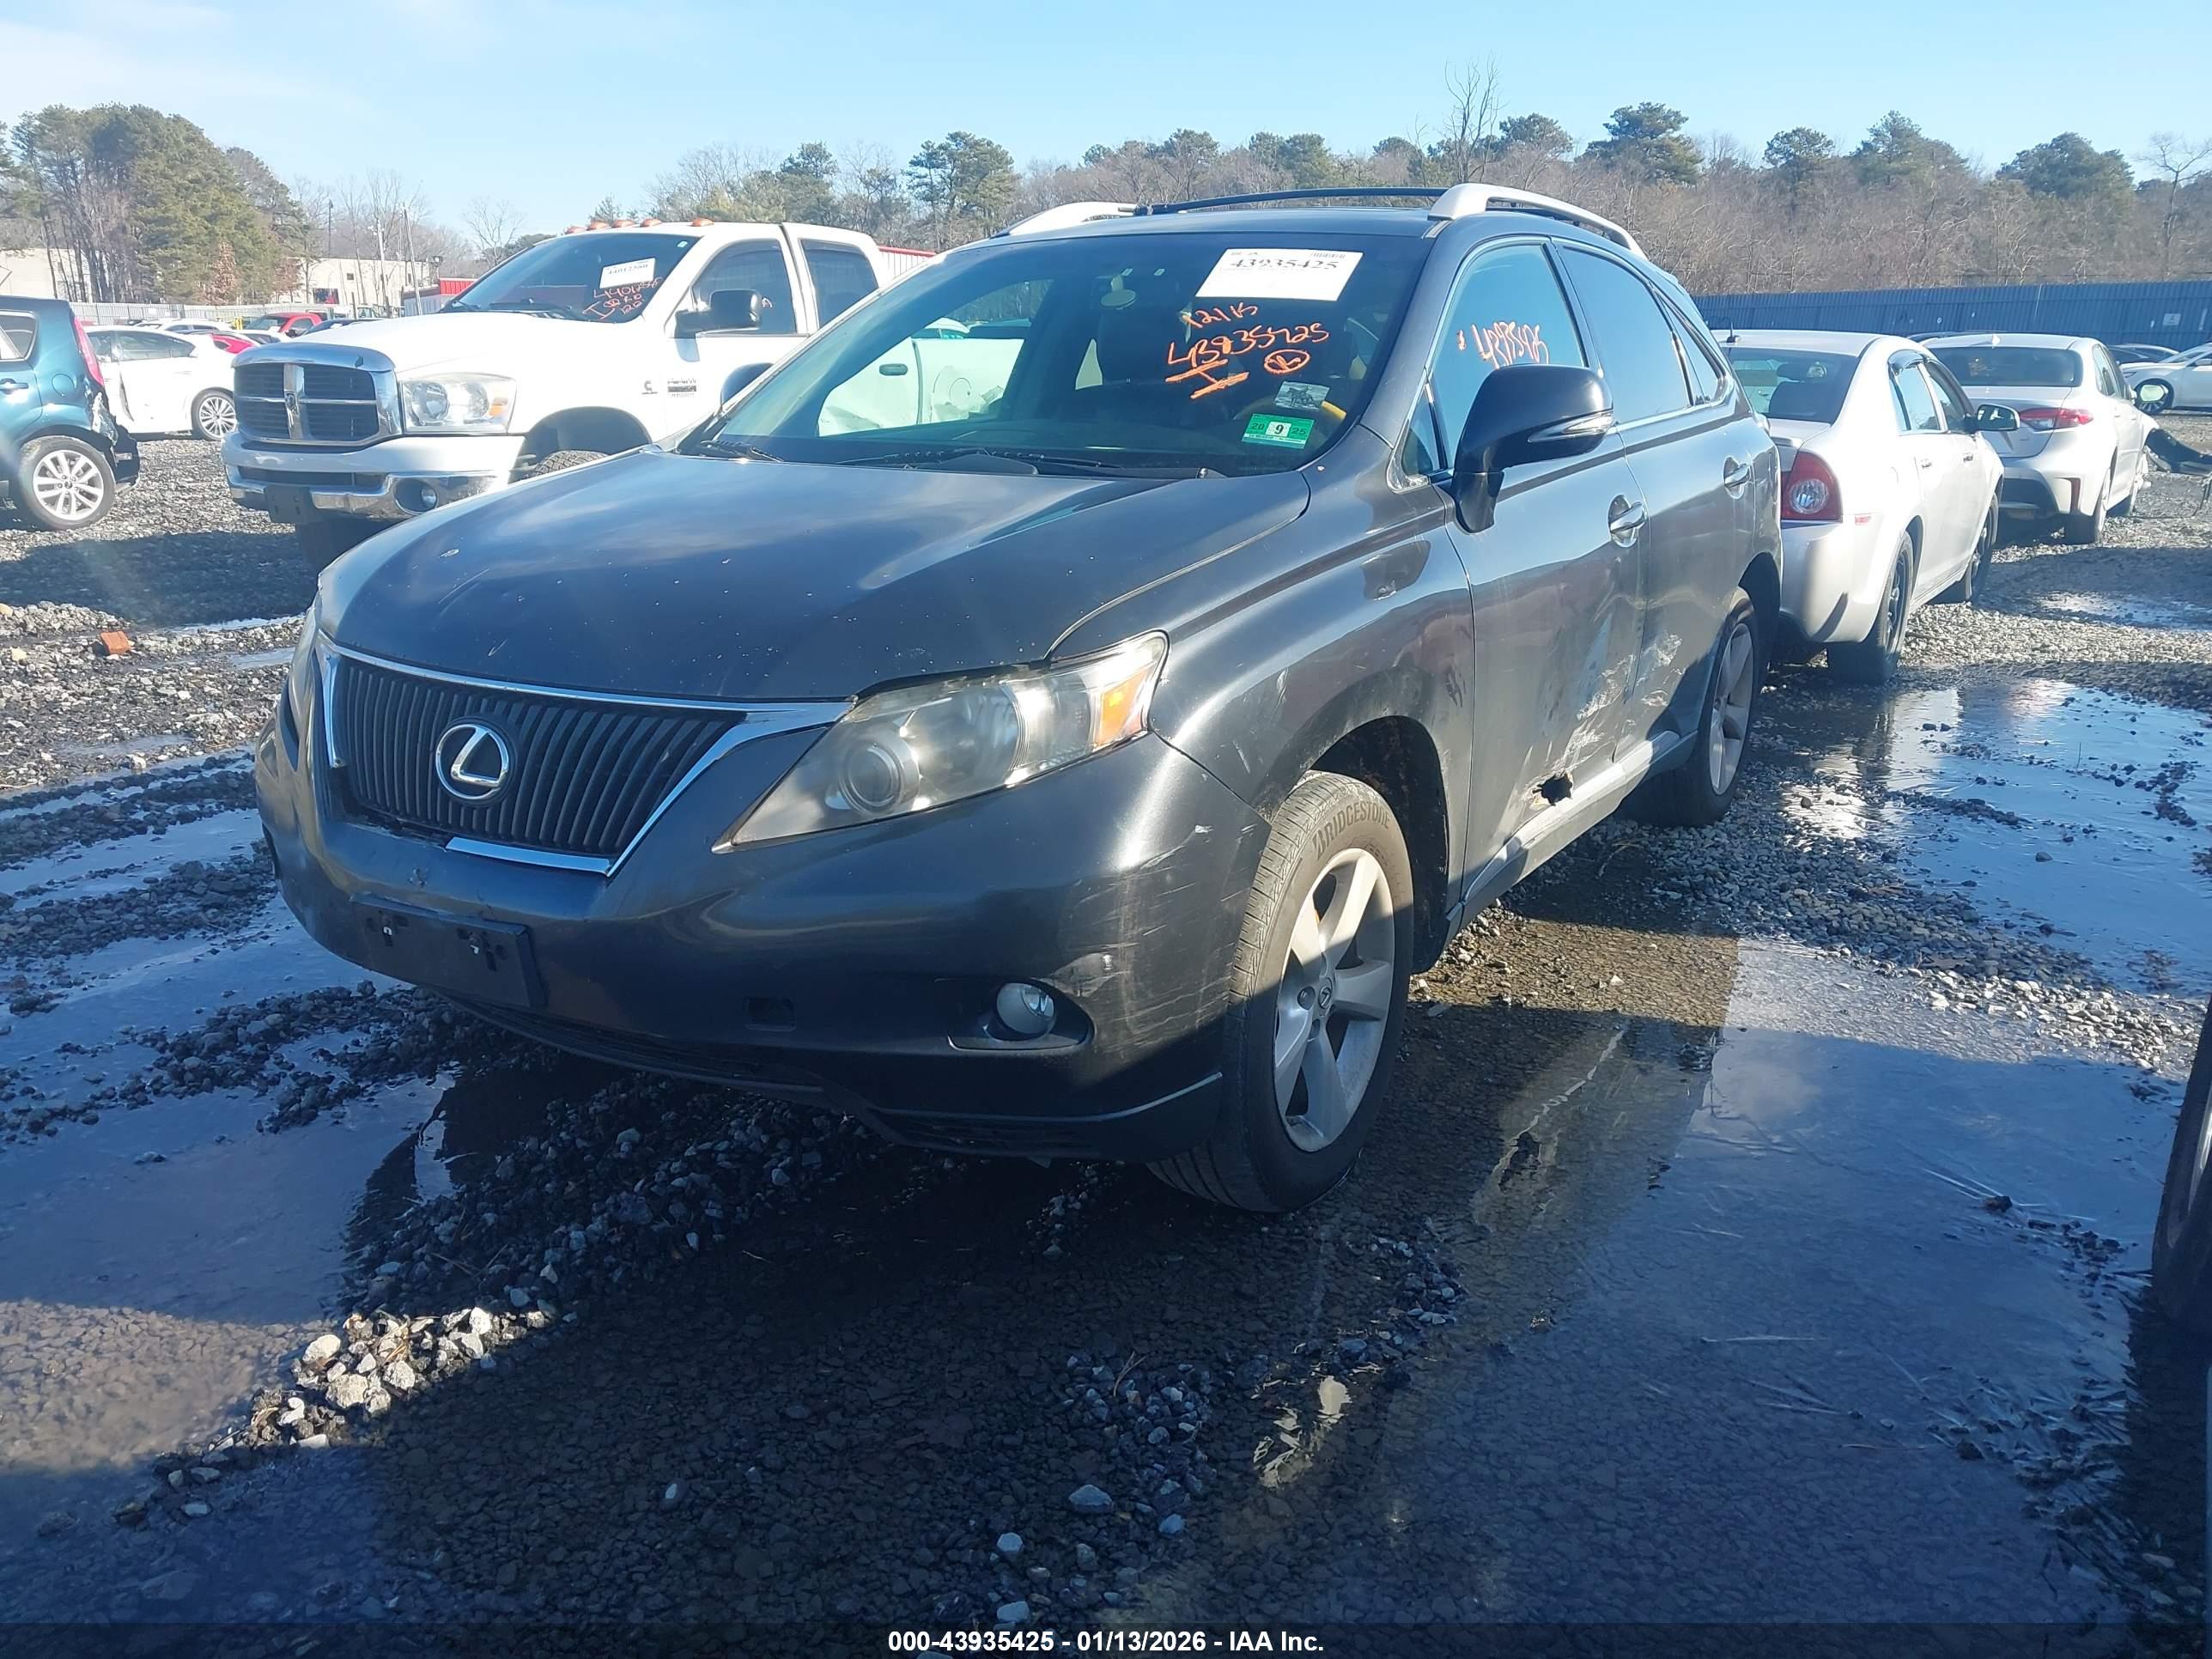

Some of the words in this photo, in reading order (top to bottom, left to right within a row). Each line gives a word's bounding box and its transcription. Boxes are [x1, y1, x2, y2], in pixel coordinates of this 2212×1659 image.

[1231, 258, 1340, 270] 43935425
[1250, 422, 1266, 430] 20
[1274, 423, 1285, 434] 9
[1291, 427, 1307, 435] 25
